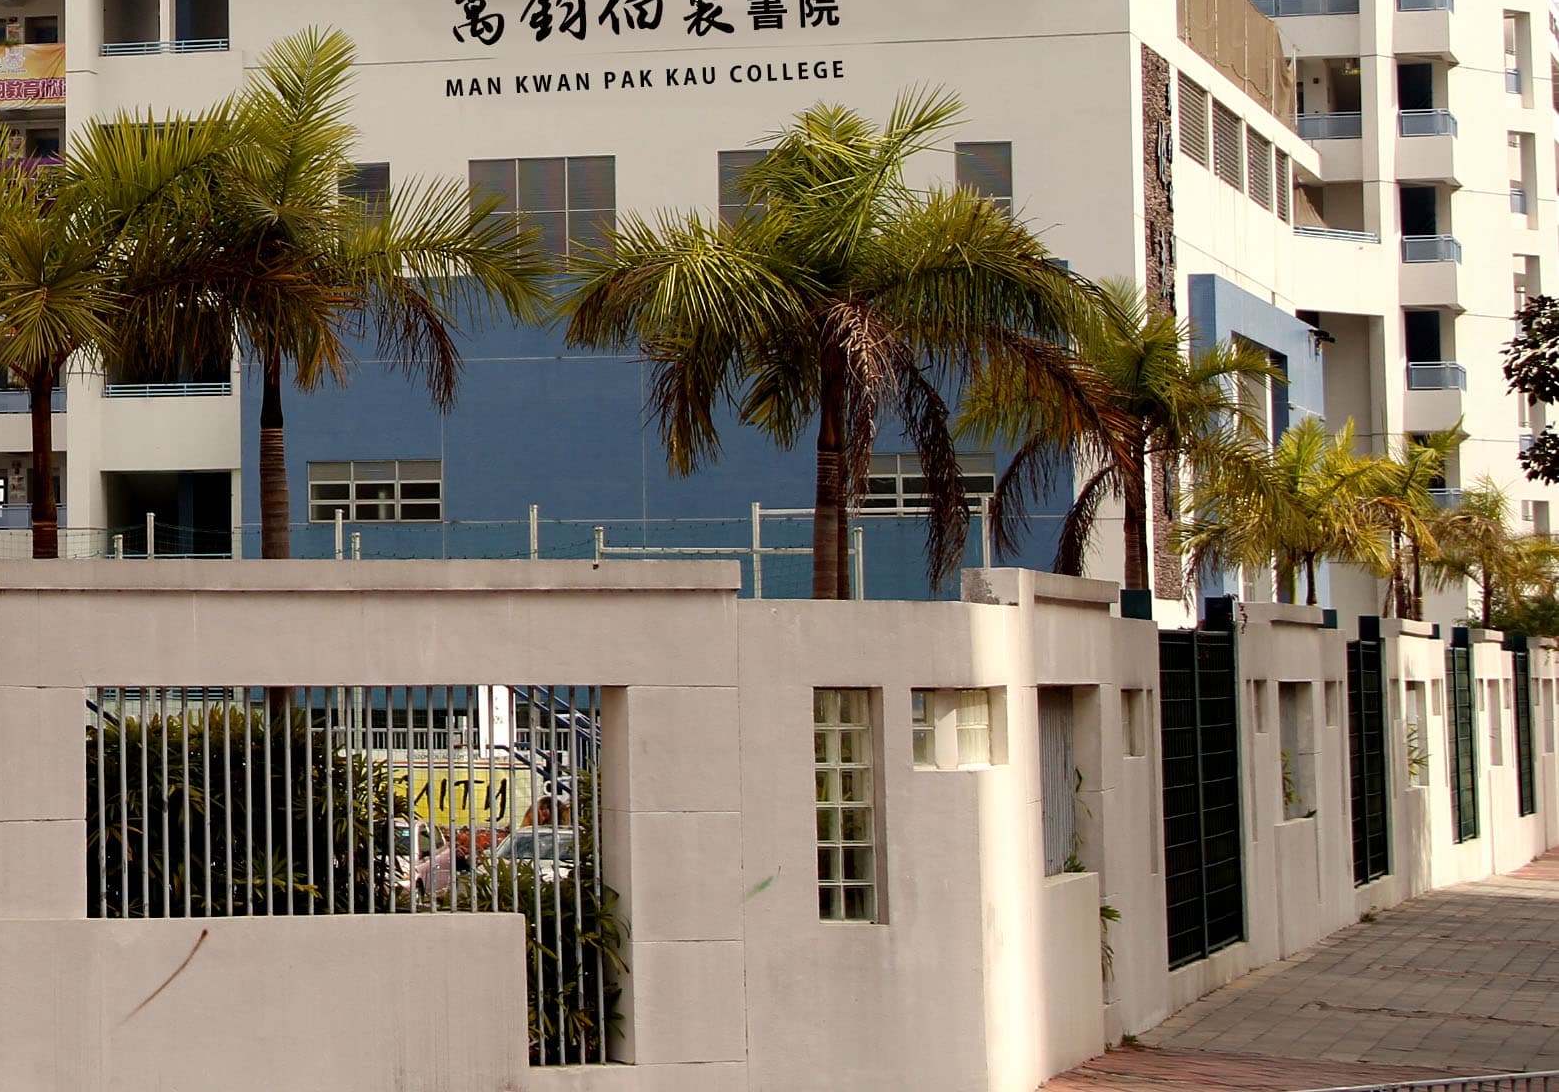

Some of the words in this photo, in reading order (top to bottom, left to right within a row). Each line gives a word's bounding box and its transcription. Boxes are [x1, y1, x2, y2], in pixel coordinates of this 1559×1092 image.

[445, 77, 503, 97] MAN
[515, 73, 591, 93] KWAN
[604, 70, 654, 90] PAK
[666, 66, 717, 86] KAU
[730, 60, 845, 83] COLLEGE
